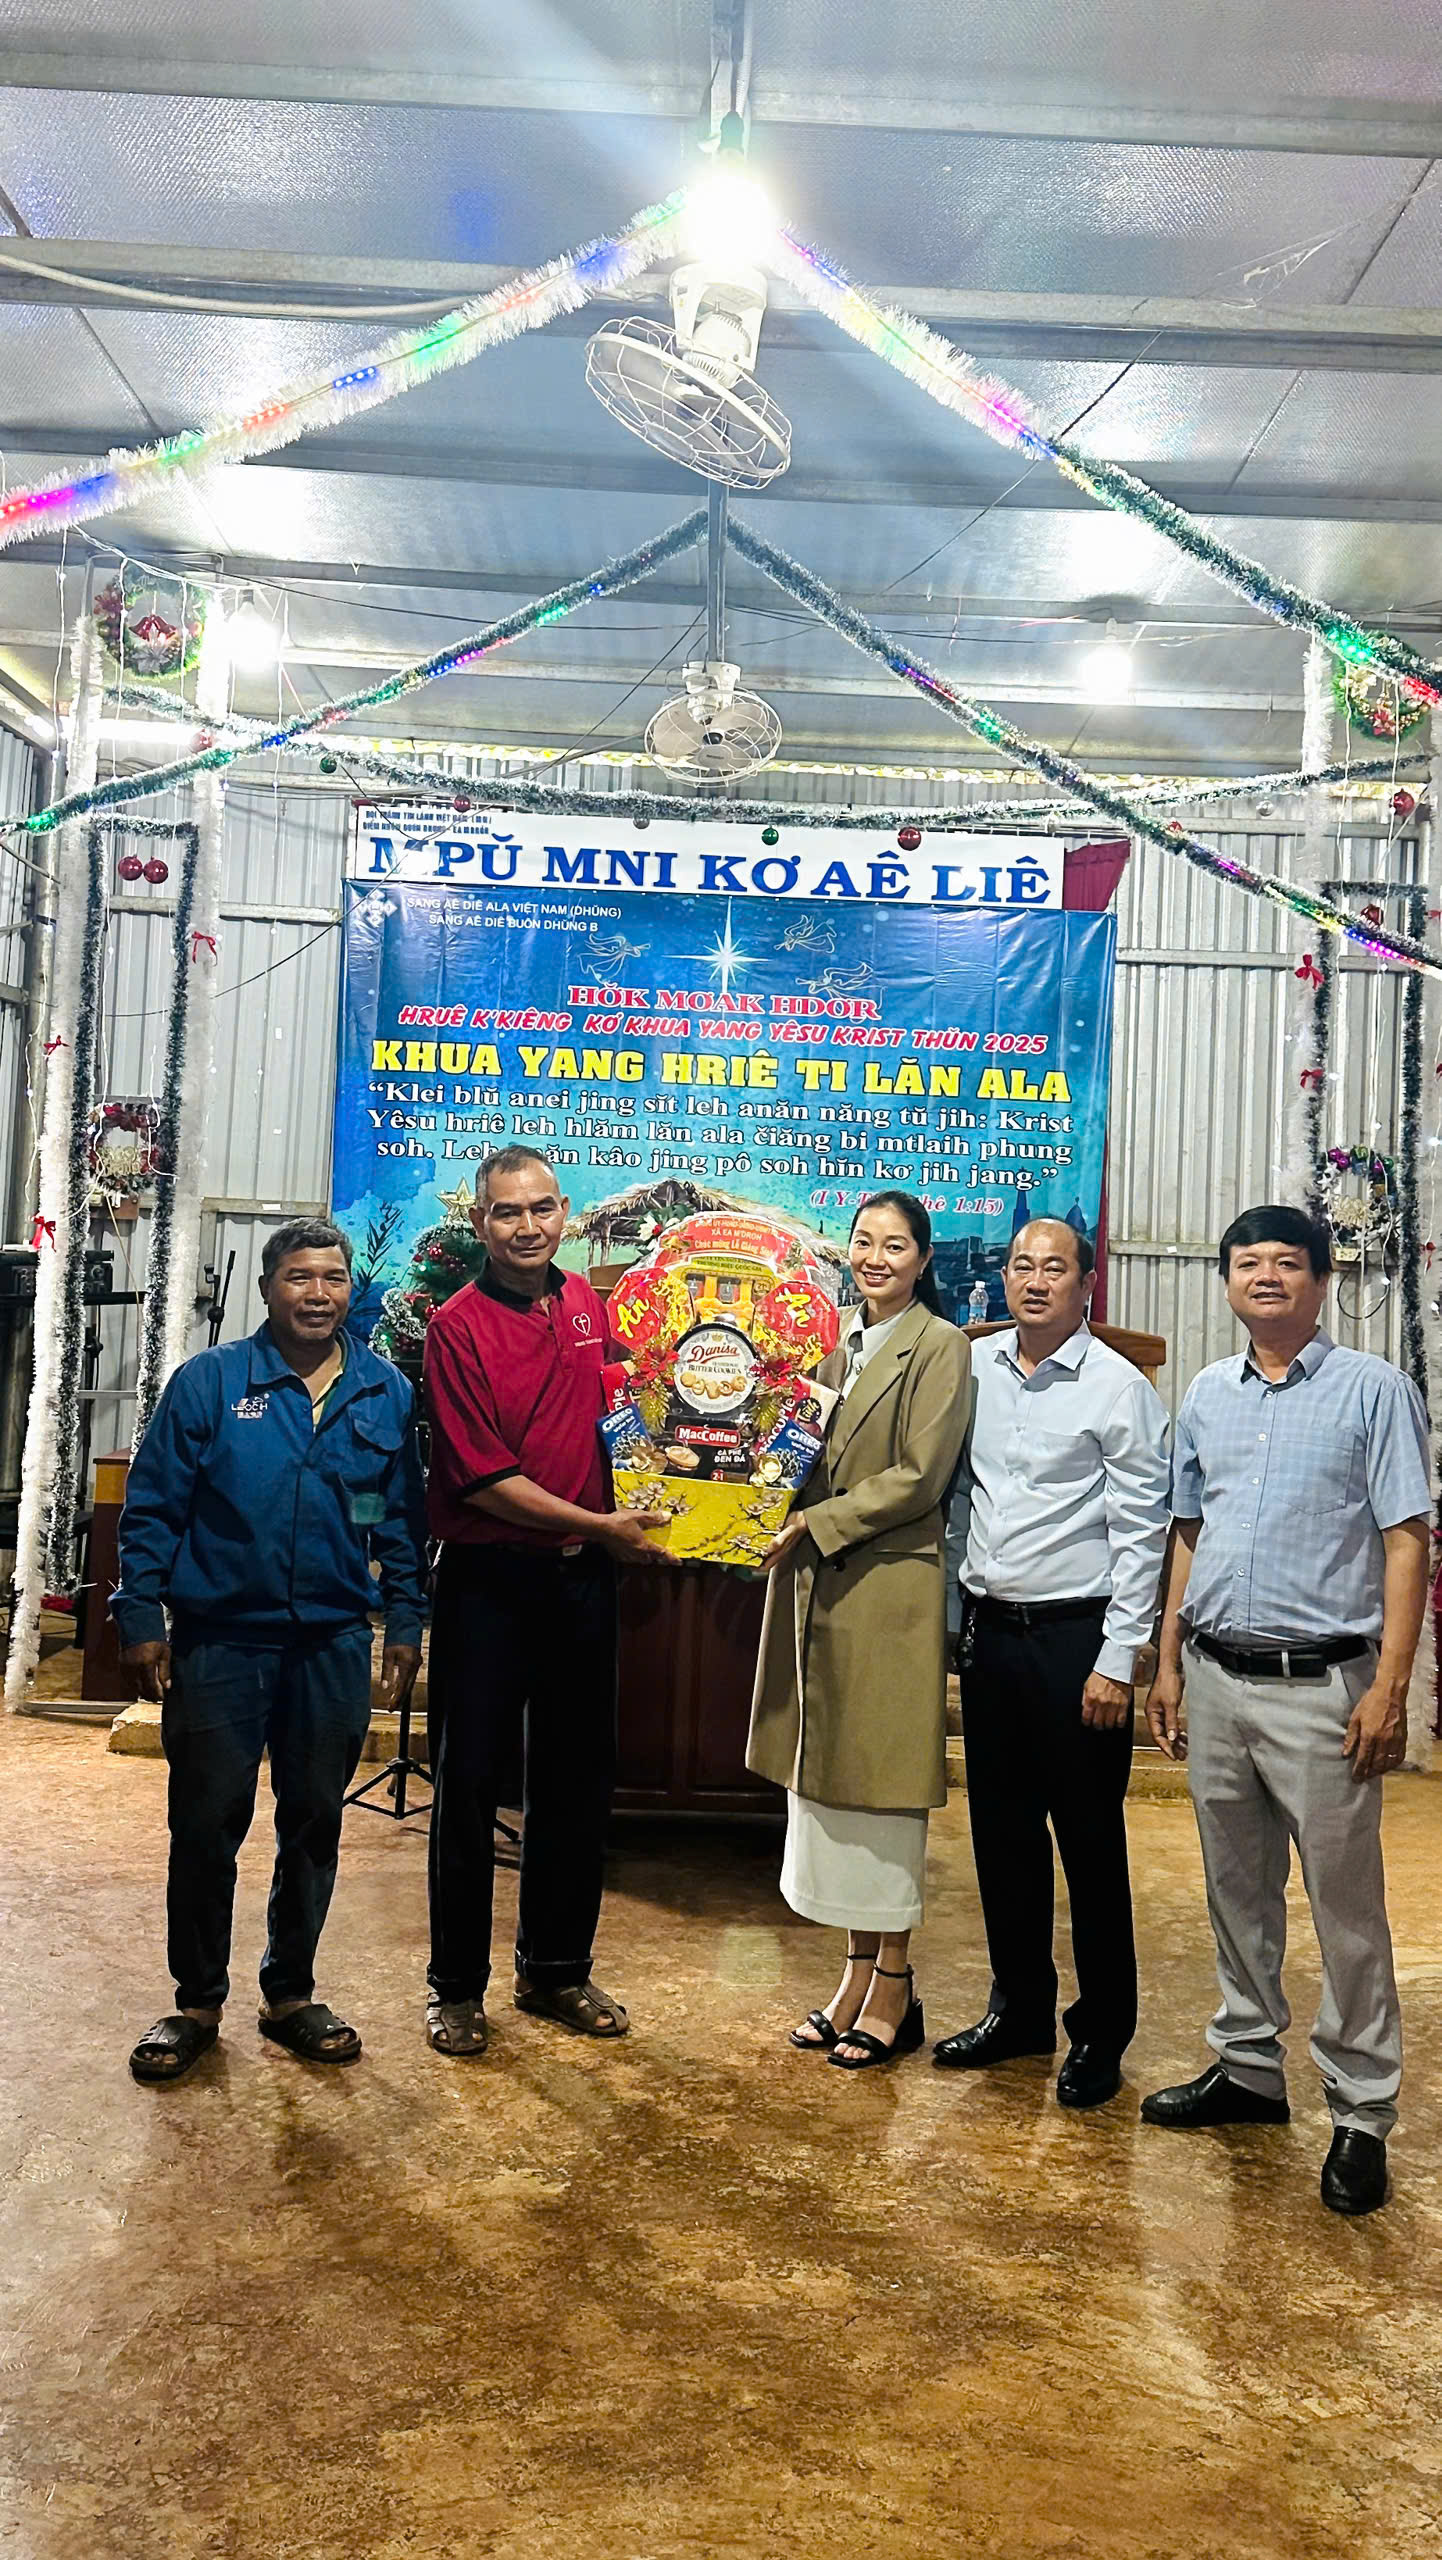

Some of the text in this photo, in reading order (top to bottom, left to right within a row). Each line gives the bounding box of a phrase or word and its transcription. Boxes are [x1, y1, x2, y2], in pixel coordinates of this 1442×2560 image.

[542, 846, 679, 888] MNI
[697, 854, 802, 895] KƠ
[810, 850, 911, 899] AÊ
[931, 856, 1052, 904] LIÊ
[407, 897, 441, 909] SANG
[463, 899, 483, 911] DIÊ
[485, 901, 509, 913] ALA
[512, 901, 539, 915] VIỆT
[541, 904, 567, 915] NAM
[429, 914, 463, 926] SANG
[484, 916, 505, 928] DIÊ
[589, 922, 598, 932] B
[398, 1004, 468, 1027] HRUÊ
[583, 1012, 624, 1035] KƠ
[624, 1016, 690, 1037] KHUA
[699, 1019, 761, 1040] YANG
[769, 1019, 829, 1043] YÊSU
[831, 1025, 906, 1047] KRIST
[912, 1026, 979, 1051] THŬN
[983, 1033, 1048, 1055] 2025
[371, 1040, 1072, 1103] KHUA YANG HRIÊ TI LĂN ALA
[454, 1084, 500, 1107] blŭ
[509, 1088, 570, 1109] anei
[575, 1089, 636, 1118] jing
[686, 1095, 729, 1117] leh
[737, 1099, 810, 1121] anăn
[819, 1102, 891, 1129] năng
[899, 1105, 929, 1126] tŭ
[935, 1106, 988, 1132] jih:
[997, 1110, 1073, 1133] Krist
[367, 1108, 437, 1131] Yêsu
[446, 1112, 506, 1134] hriê
[512, 1114, 557, 1136] leh
[565, 1116, 639, 1140] hlăm
[647, 1120, 693, 1143] lăn
[701, 1124, 745, 1145] ala
[840, 1129, 868, 1151] bi
[877, 1133, 971, 1156] mtlaih
[979, 1137, 1073, 1166] phung
[376, 1137, 434, 1159] soh.
[588, 1145, 643, 1168] kâo
[648, 1148, 708, 1176] jing
[715, 1152, 752, 1177] pô
[760, 1154, 809, 1176] soh
[873, 1158, 914, 1181] kơ
[917, 1160, 960, 1187] jih
[953, 1197, 1005, 1216] 1:15)
[687, 1342, 739, 1363] Danisa
[602, 1407, 633, 1432] OREO
[678, 1427, 738, 1444] MacCoffee
